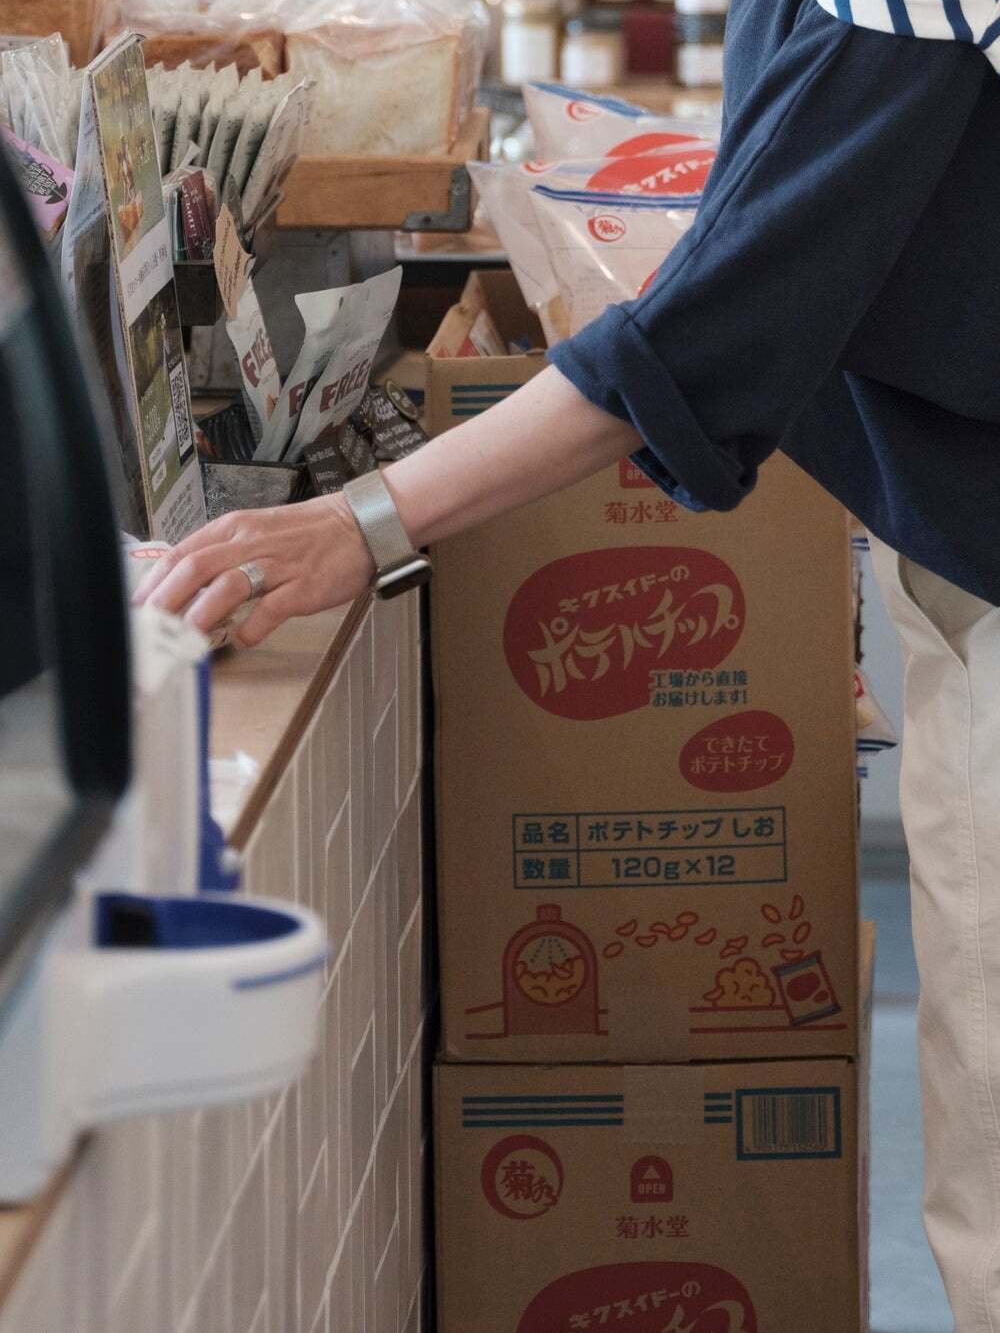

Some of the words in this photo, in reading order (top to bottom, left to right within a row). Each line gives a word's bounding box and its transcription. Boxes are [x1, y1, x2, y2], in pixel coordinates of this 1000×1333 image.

[605, 500, 679, 524] 菊水堂
[557, 565, 690, 613] キクスイドーの
[527, 582, 740, 698] ポテトチップ
[653, 669, 748, 687] 工場から直接
[703, 735, 769, 754] できたて
[689, 753, 785, 774] ポテトチップ
[522, 820, 571, 844] 品名
[587, 816, 723, 842] ポテトチップ
[731, 816, 775, 839] しお
[522, 857, 571, 880] 数量
[637, 1181, 667, 1195] OPEN
[615, 1215, 690, 1239] 菊水堂
[568, 1279, 702, 1329] キクスイドーの
